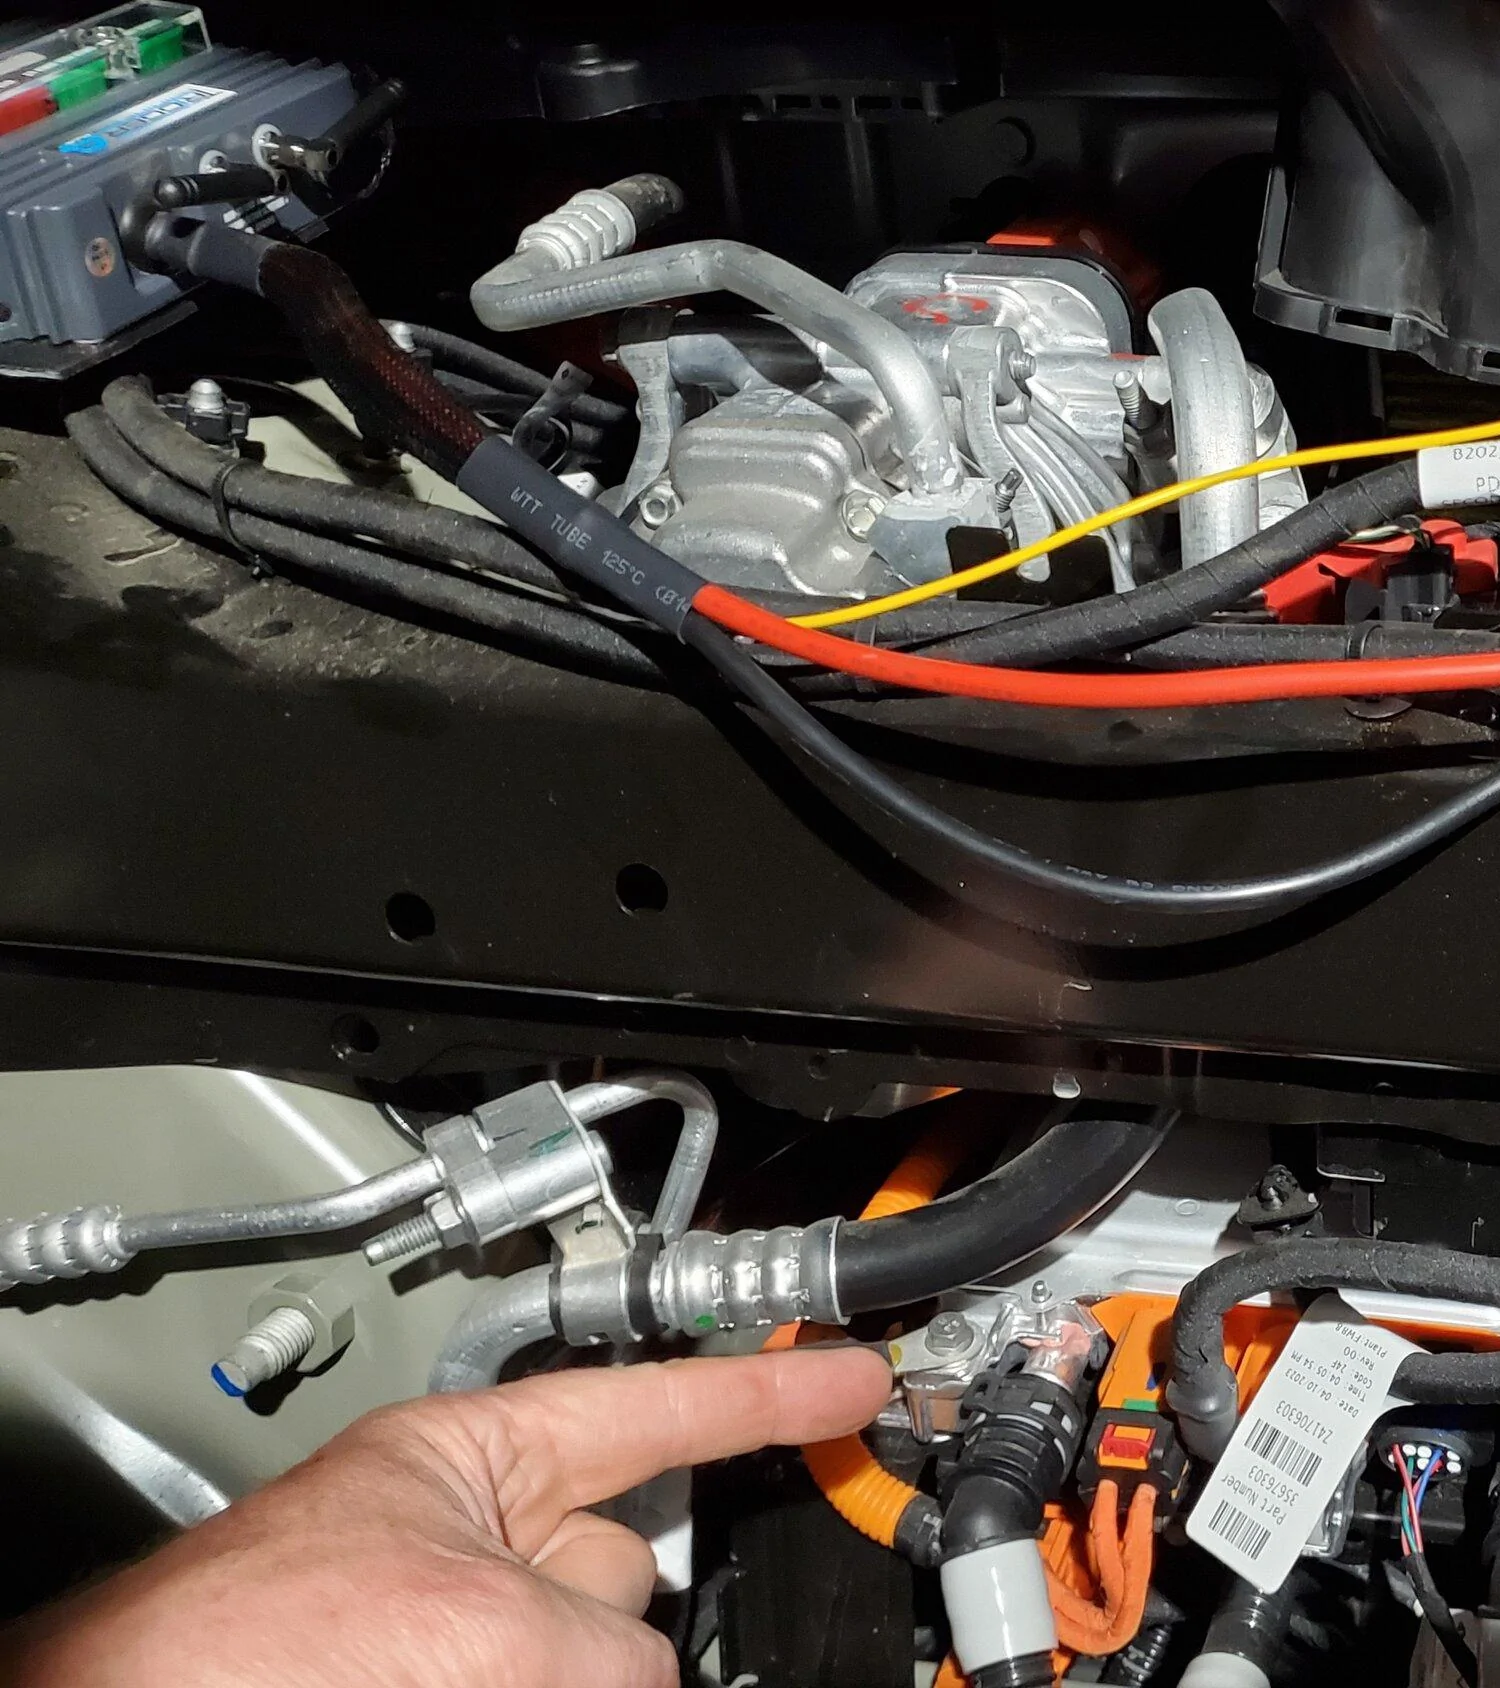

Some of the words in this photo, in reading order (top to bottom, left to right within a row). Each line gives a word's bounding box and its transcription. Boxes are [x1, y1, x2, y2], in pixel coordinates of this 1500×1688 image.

[510, 486, 544, 515] WTT
[550, 513, 593, 550] TUBE
[600, 549, 645, 587] 125°C
[1290, 1349, 1303, 1365] PM
[1220, 1473, 1260, 1507] Number
[1248, 1465, 1300, 1507] 35676303
[1259, 1499, 1287, 1526] Part
